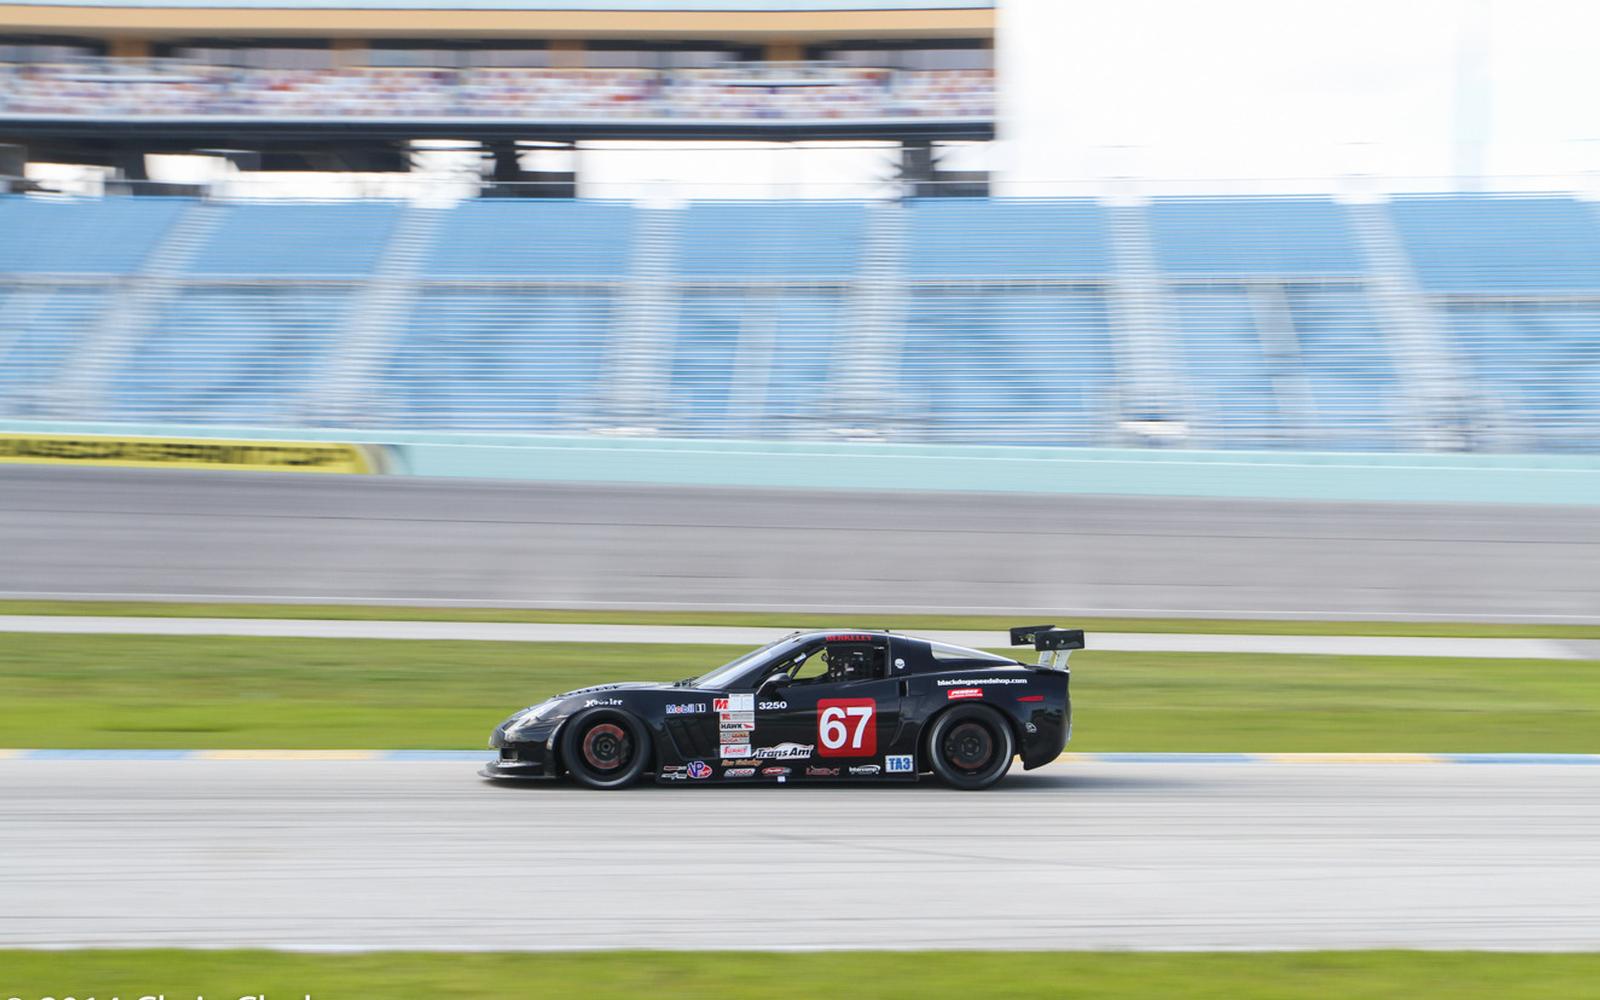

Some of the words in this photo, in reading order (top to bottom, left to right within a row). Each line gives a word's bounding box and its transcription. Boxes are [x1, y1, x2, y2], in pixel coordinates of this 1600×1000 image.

[666, 704, 694, 713] Mobil
[759, 701, 787, 710] 3250
[819, 706, 873, 749] 67
[757, 748, 788, 757] Trans
[789, 747, 809, 757] Am
[889, 758, 910, 770] TA3
